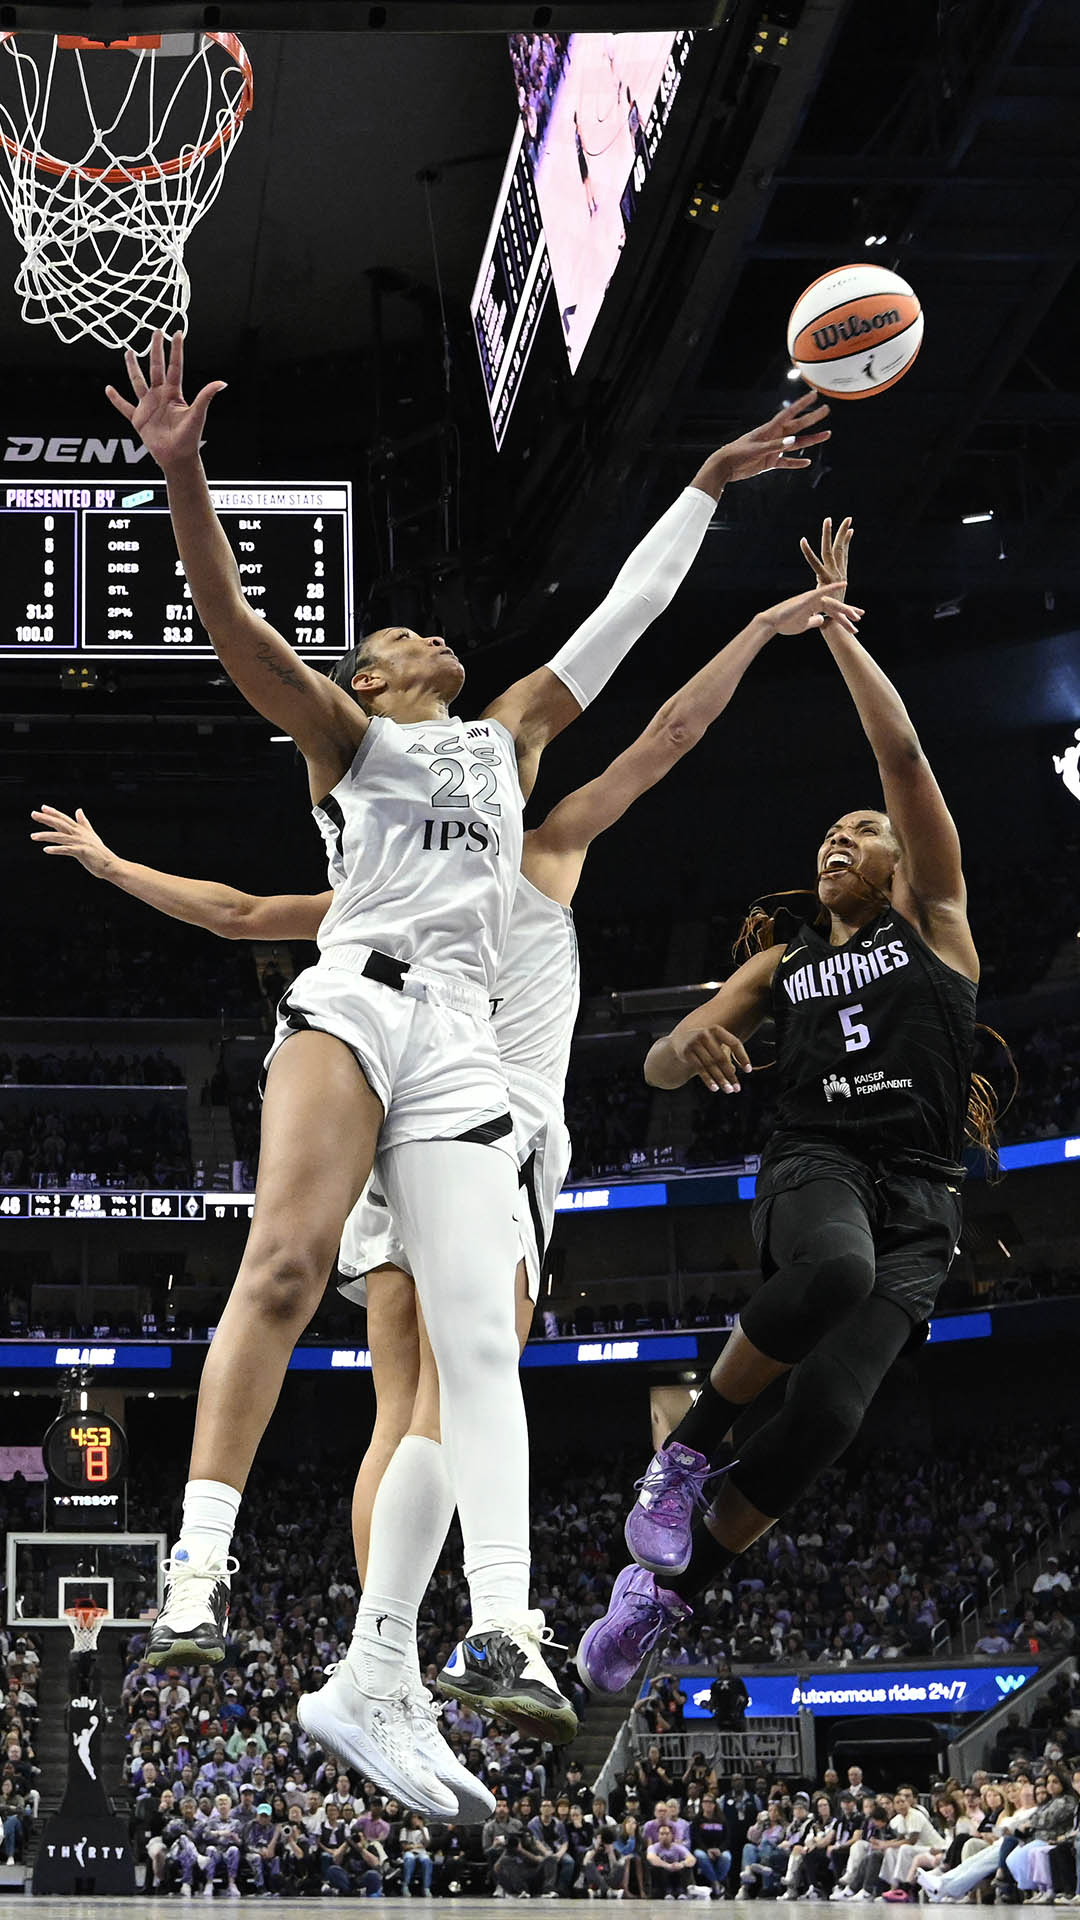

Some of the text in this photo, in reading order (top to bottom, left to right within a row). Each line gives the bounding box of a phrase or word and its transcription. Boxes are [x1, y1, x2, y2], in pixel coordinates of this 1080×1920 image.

[811, 309, 899, 351] Wilson
[3, 436, 207, 464] DENV
[7, 489, 90, 507] PRESENTED
[96, 490, 115, 508] BY
[219, 494, 253, 505] VEGAS
[257, 494, 286, 505] TEAM
[289, 494, 323, 505] STATS
[45, 516, 54, 531] 0
[108, 519, 130, 528] AST
[239, 520, 261, 529] BLK
[313, 517, 323, 532] 4
[108, 541, 139, 551] OREB
[239, 542, 254, 551] TO
[108, 563, 139, 573] DREB
[240, 564, 262, 573] POT
[315, 561, 324, 576] 2
[108, 585, 128, 595] STL
[108, 608, 132, 617] 2P%
[16, 626, 53, 641] 100.0
[108, 630, 133, 639] 3P%
[405, 736, 502, 767] ACS
[429, 757, 501, 817] 22
[783, 940, 910, 1005] VALKYRIES
[837, 1003, 871, 1053] 5
[854, 1071, 885, 1085] KAISER
[856, 1078, 913, 1096] PERMANENTE
[71, 1427, 110, 1446] 4:53
[86, 1446, 108, 1482] 8
[71, 1495, 119, 1506] TISSOT
[791, 1681, 967, 1705] Autonomous rides 24/7
[71, 1696, 98, 1711] ally
